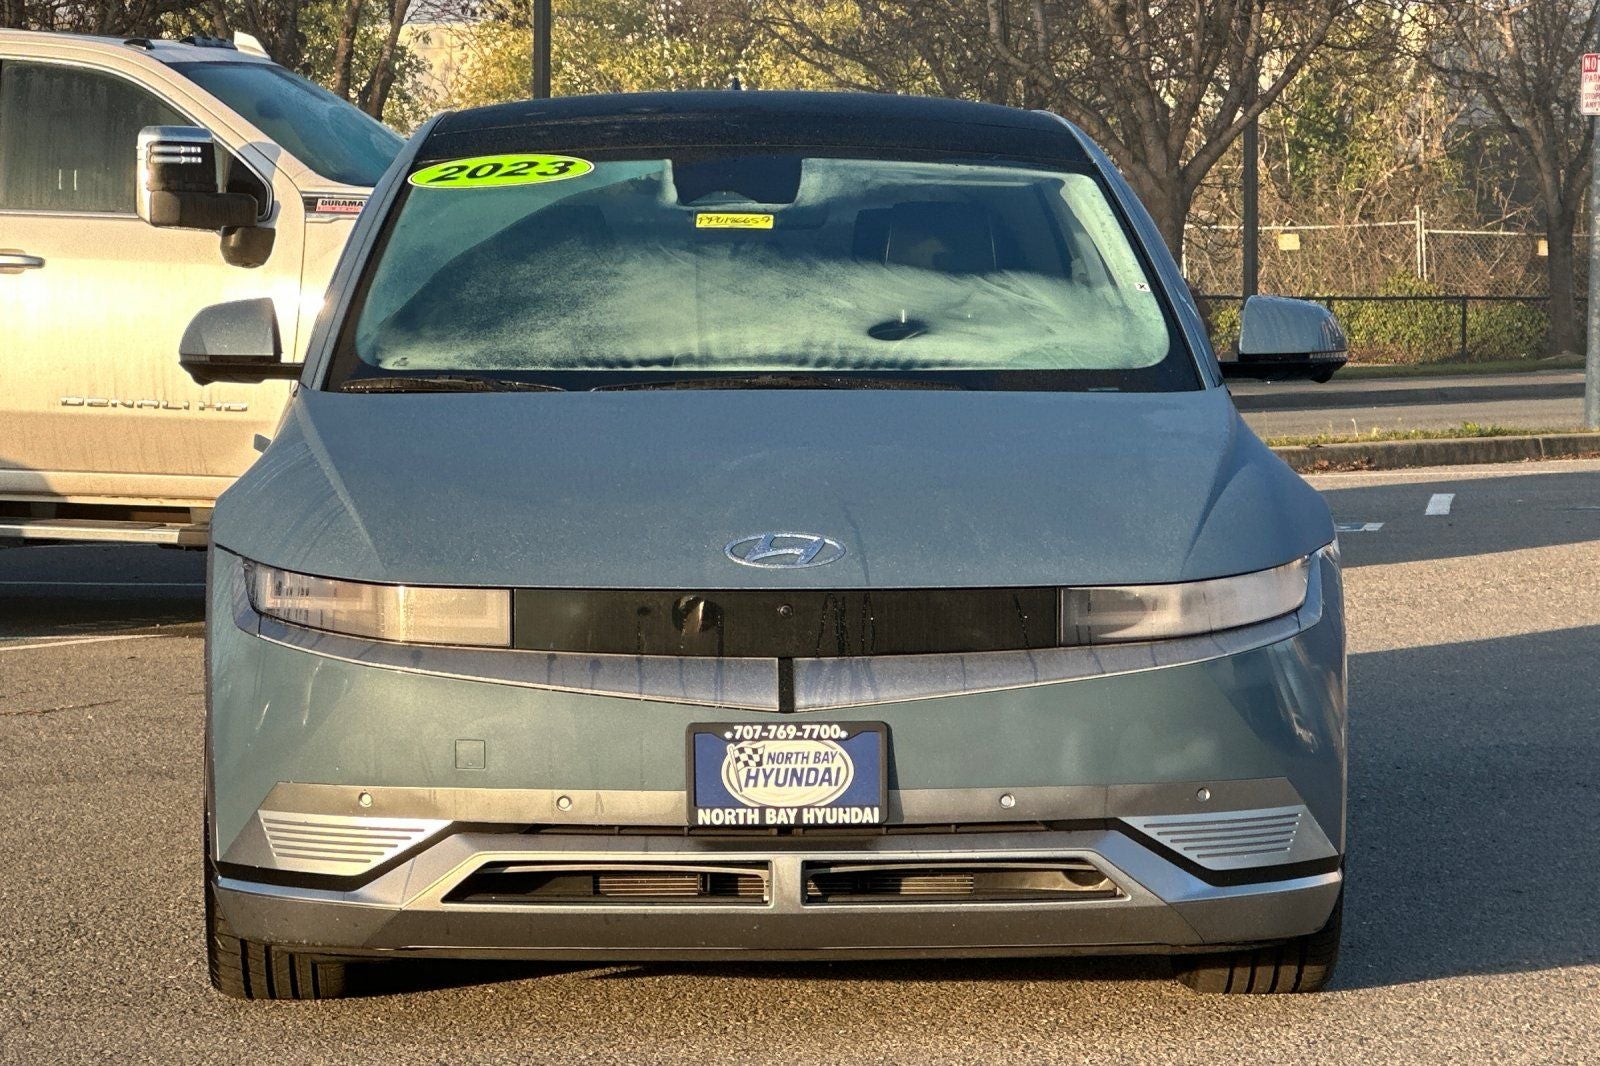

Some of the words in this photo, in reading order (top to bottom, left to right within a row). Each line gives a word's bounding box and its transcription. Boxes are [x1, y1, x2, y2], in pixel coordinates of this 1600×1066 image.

[1584, 57, 1597, 70] NO
[426, 159, 576, 183] 2023
[321, 199, 366, 207] DURAMA
[61, 397, 190, 410] DENALI
[198, 401, 248, 411] HD
[733, 725, 841, 740] 707-769-7700
[766, 751, 810, 765] NORTH
[813, 750, 839, 764] BAY
[744, 766, 842, 788] HYUNDAI
[697, 808, 759, 825] NORTH
[765, 808, 798, 825] BAY
[803, 807, 880, 824] HYUNDAI
